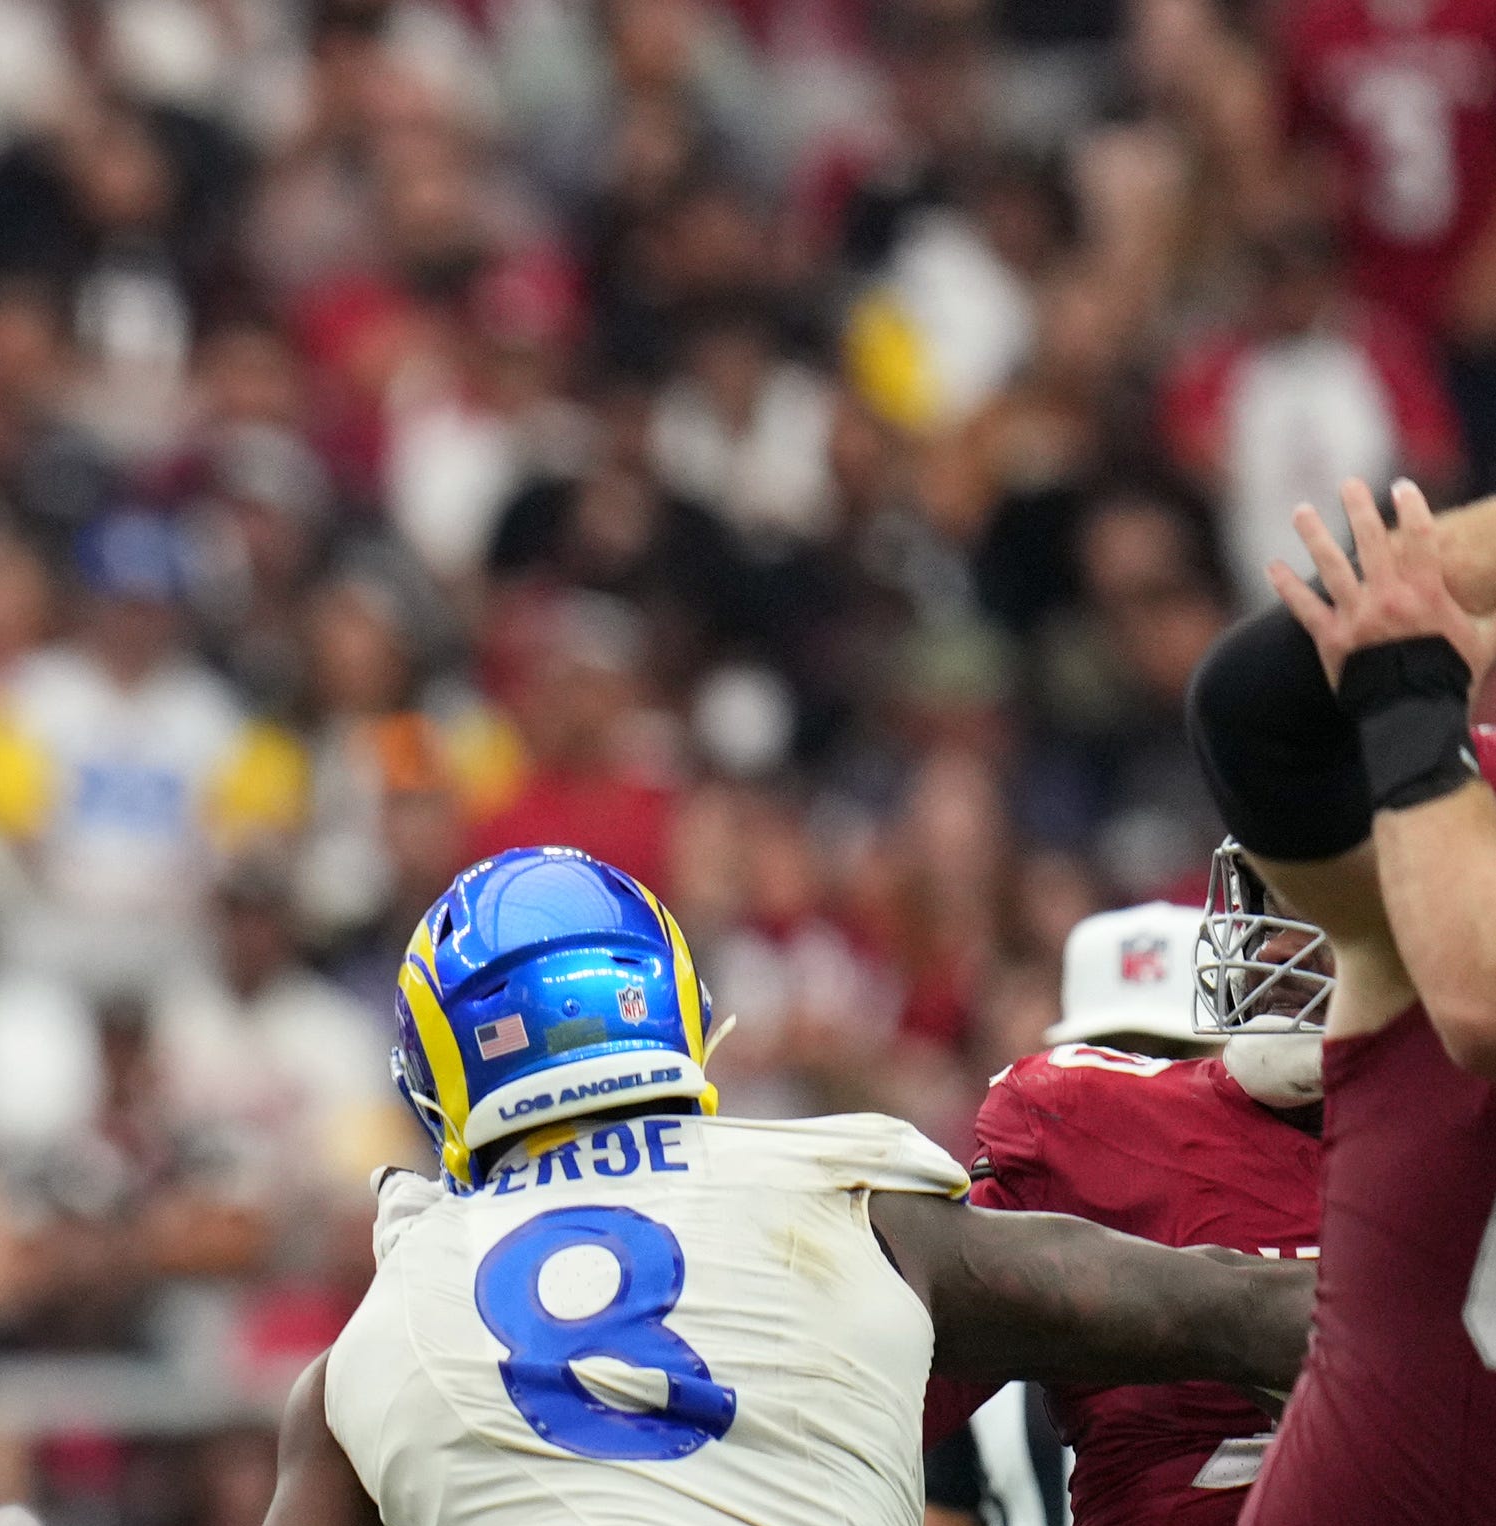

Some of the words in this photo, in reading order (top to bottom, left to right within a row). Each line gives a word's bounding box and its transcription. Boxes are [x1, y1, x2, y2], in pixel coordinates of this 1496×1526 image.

[498, 1093, 554, 1121] LOS
[559, 1067, 683, 1105] ANGELES
[474, 1205, 737, 1460] 8
